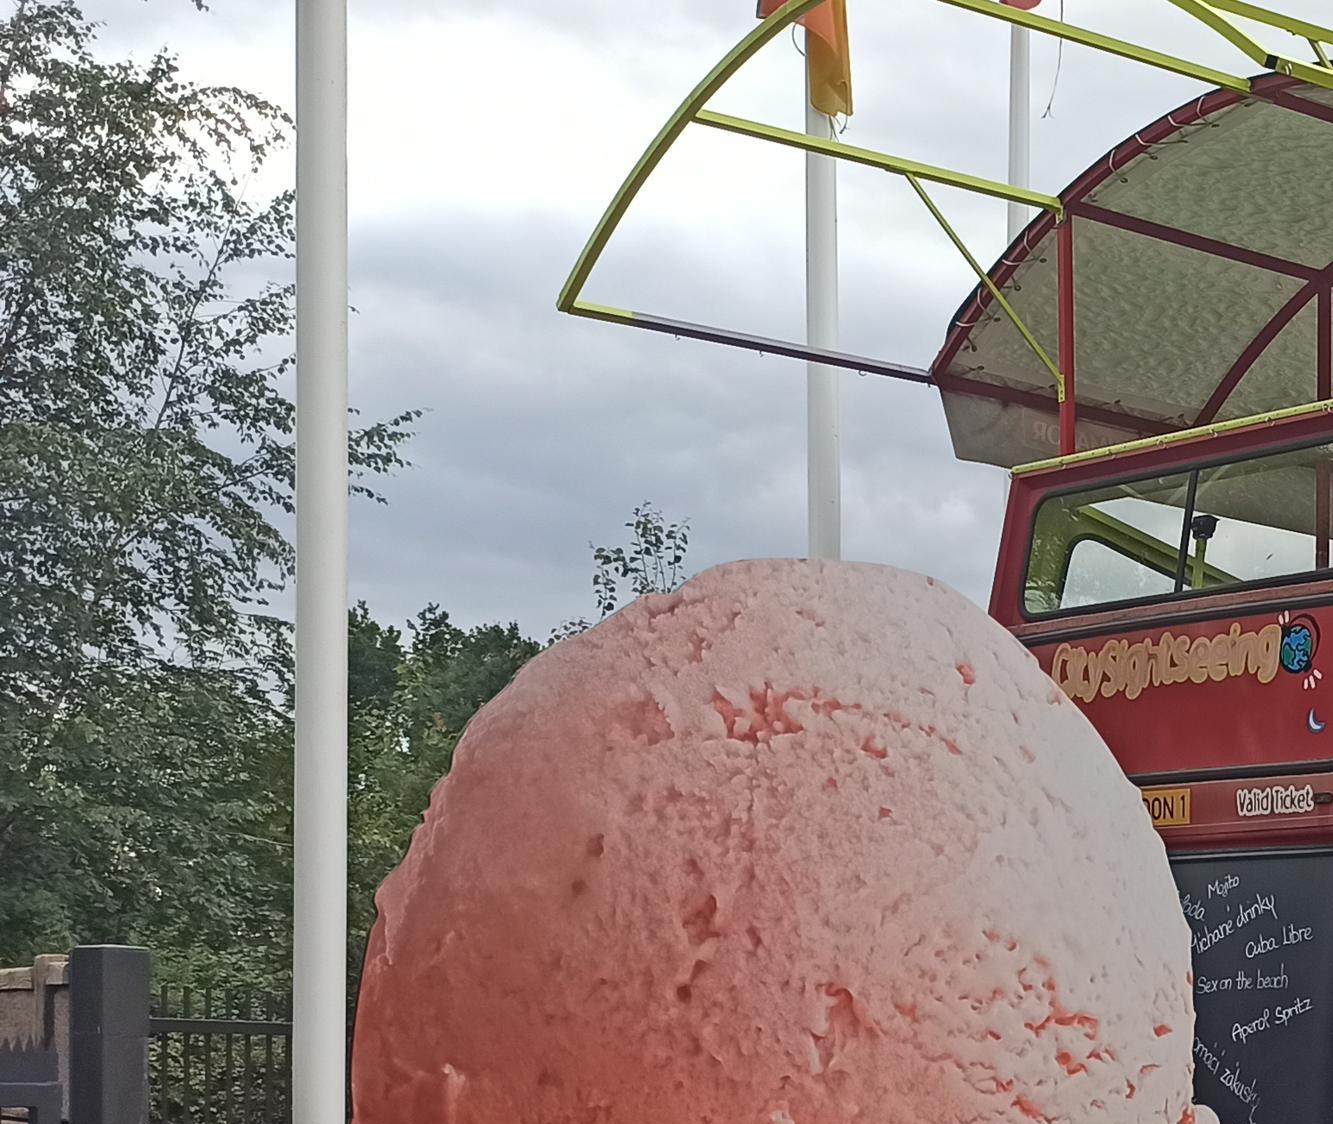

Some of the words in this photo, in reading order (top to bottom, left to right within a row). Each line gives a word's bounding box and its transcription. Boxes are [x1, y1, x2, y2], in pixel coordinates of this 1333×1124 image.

[1237, 788, 1271, 816] Valid
[1273, 784, 1314, 814] Ticket
[1208, 874, 1240, 899] Mojito
[1237, 893, 1278, 928] drinky
[1245, 933, 1280, 958] Cuba
[1282, 923, 1314, 945] Libre
[1195, 976, 1219, 994] Sex
[1219, 977, 1232, 991] on
[1236, 970, 1254, 990] the
[1257, 962, 1289, 990] beach
[1232, 1008, 1270, 1044] Aperol
[1275, 998, 1314, 1026] Spritz
